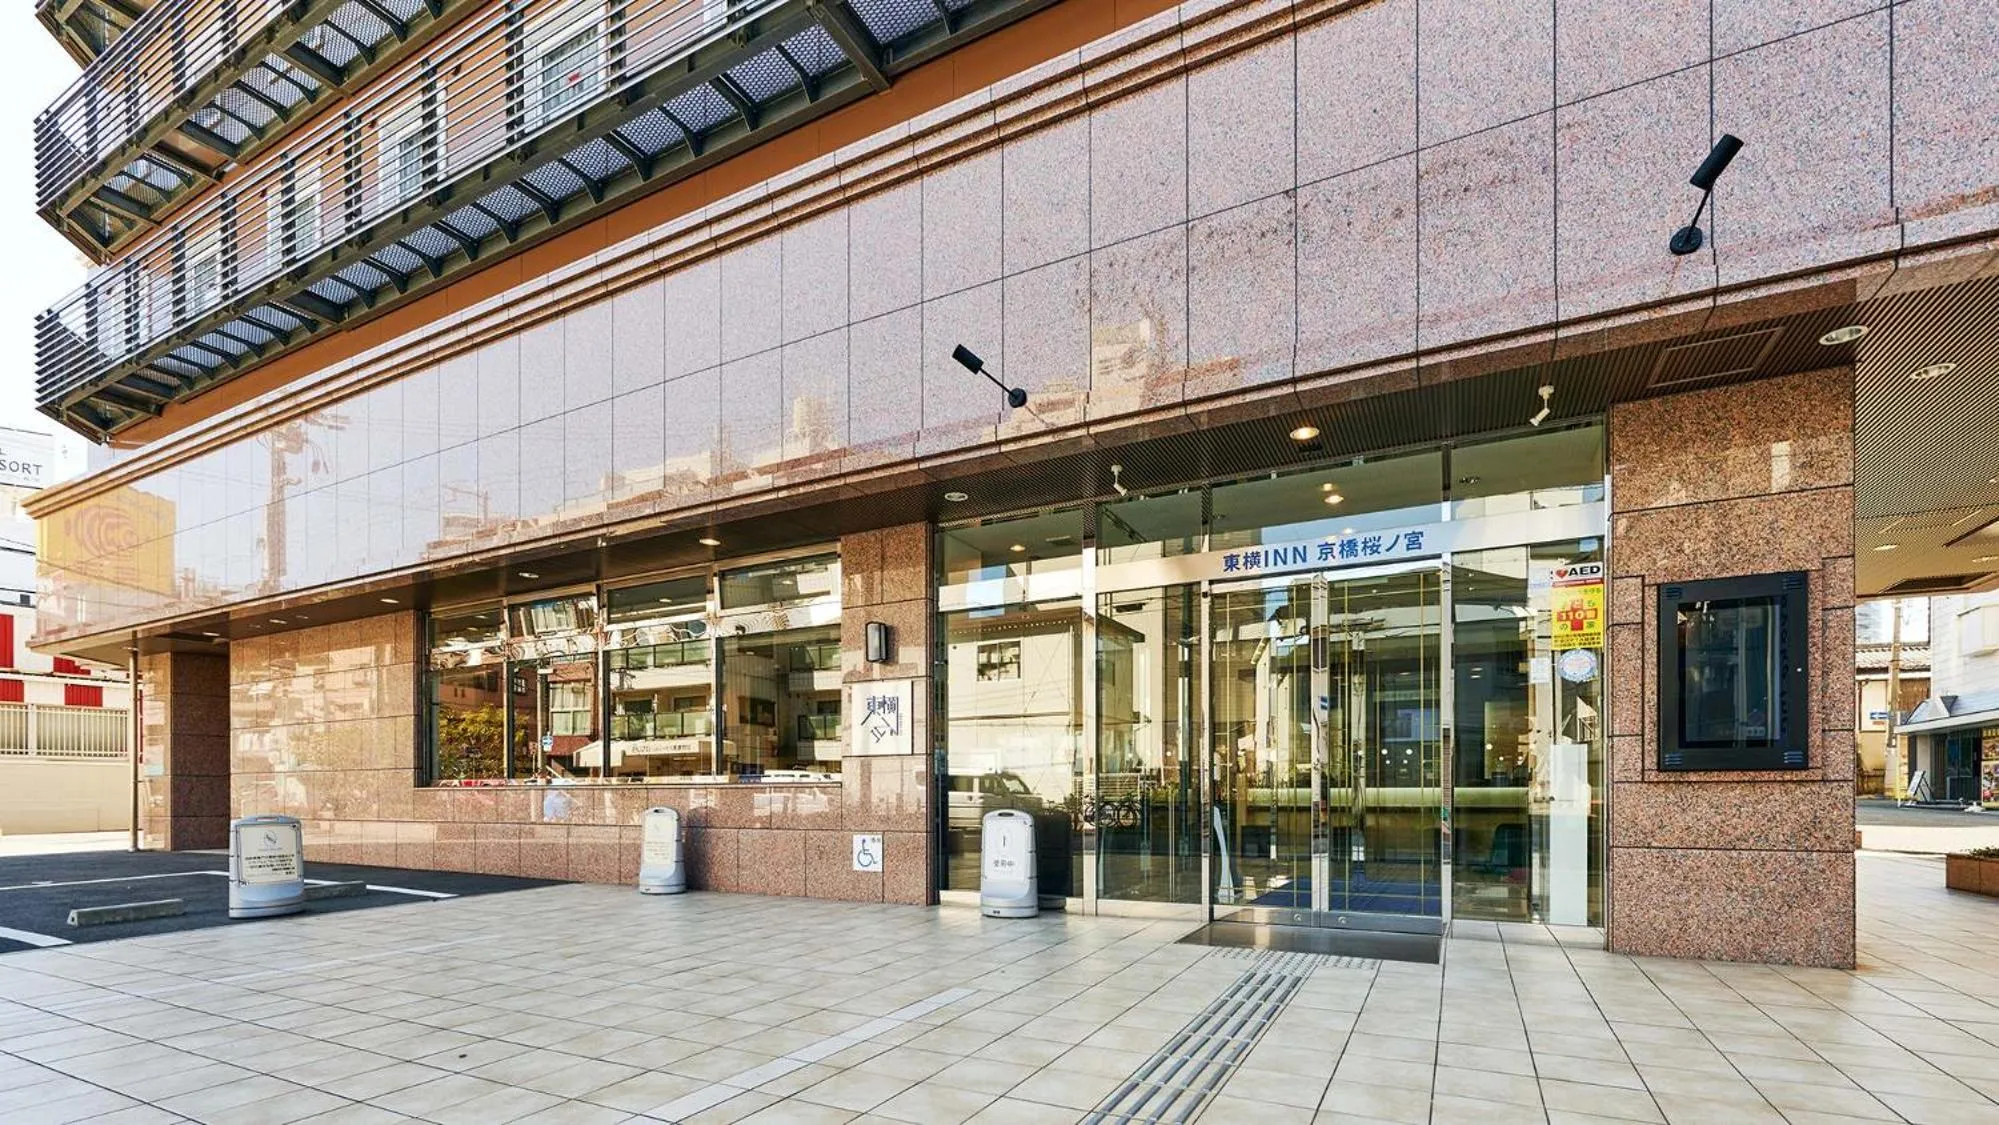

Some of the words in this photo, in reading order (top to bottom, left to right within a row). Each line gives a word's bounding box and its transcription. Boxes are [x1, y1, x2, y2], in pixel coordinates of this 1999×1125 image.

[1223, 544, 1307, 572] 東横INN
[1317, 530, 1424, 561] 京橋桜ノ宮
[1568, 565, 1601, 577] AED
